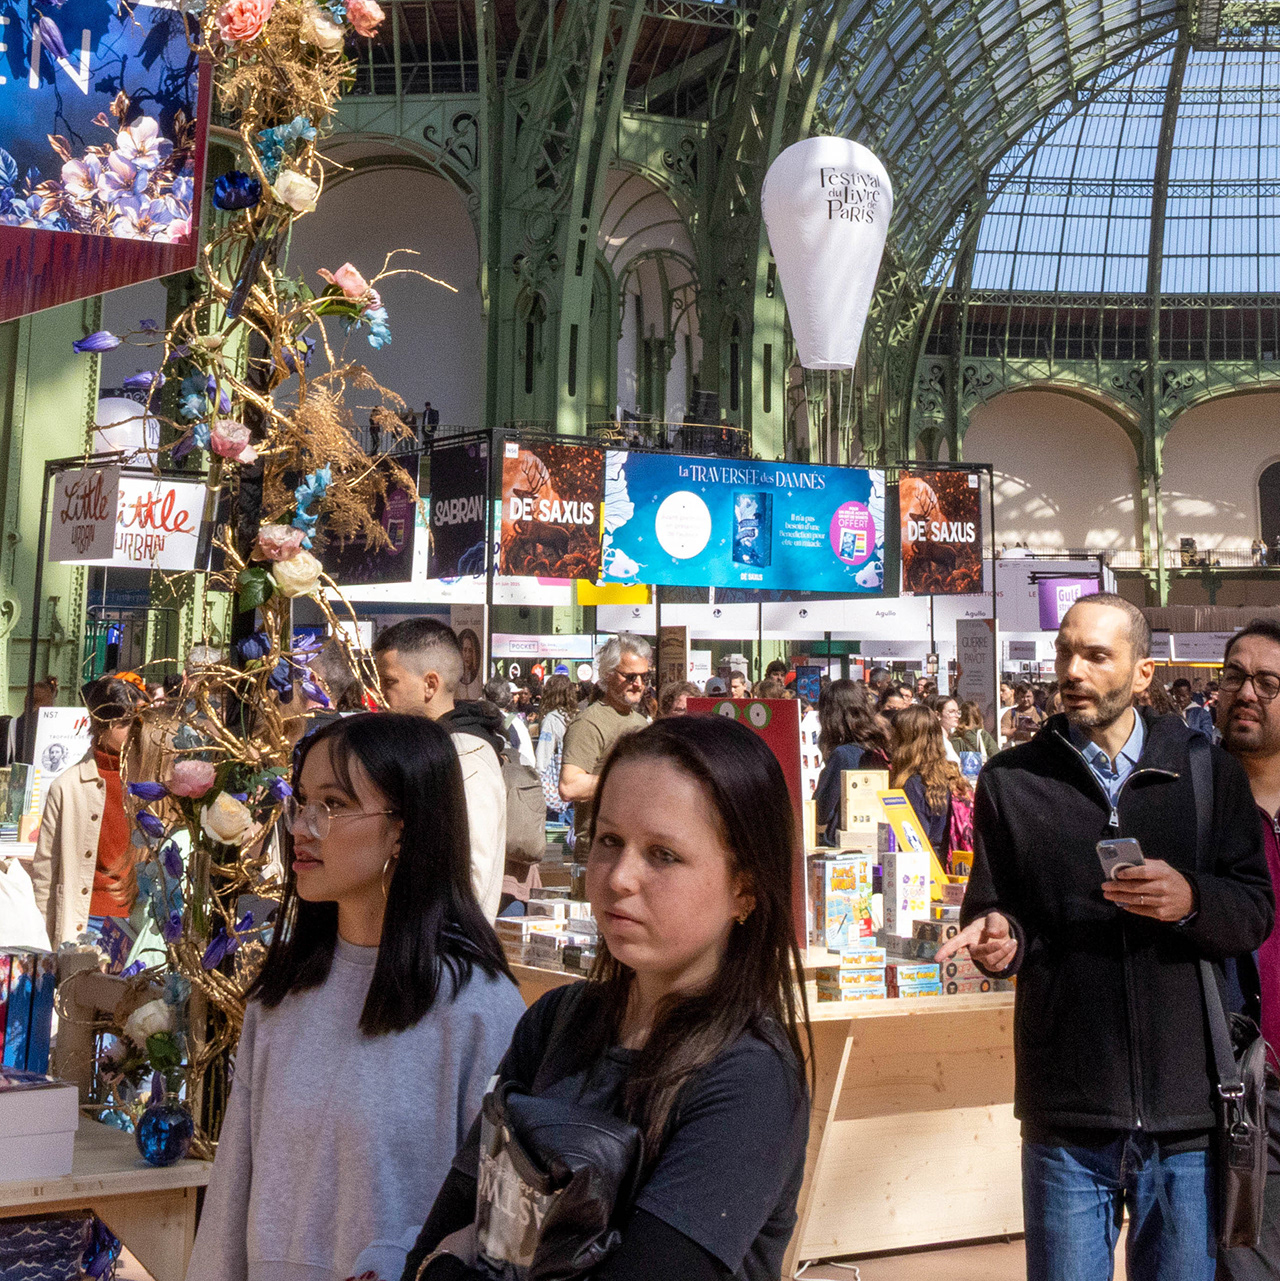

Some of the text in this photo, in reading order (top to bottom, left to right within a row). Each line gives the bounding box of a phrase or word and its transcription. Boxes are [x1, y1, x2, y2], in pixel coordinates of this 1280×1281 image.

[820, 167, 880, 188] Festival
[828, 188, 842, 197] du
[844, 186, 880, 205] Livre
[689, 465, 760, 486] TRAVERSÉE
[760, 474, 774, 484] des
[775, 471, 826, 490] DAMNÉS
[61, 470, 110, 525] Little
[434, 495, 484, 526] SABRAN
[509, 497, 594, 525] DE SAXUS
[838, 519, 868, 528] OFFERT
[907, 520, 976, 542] DE SAXUS
